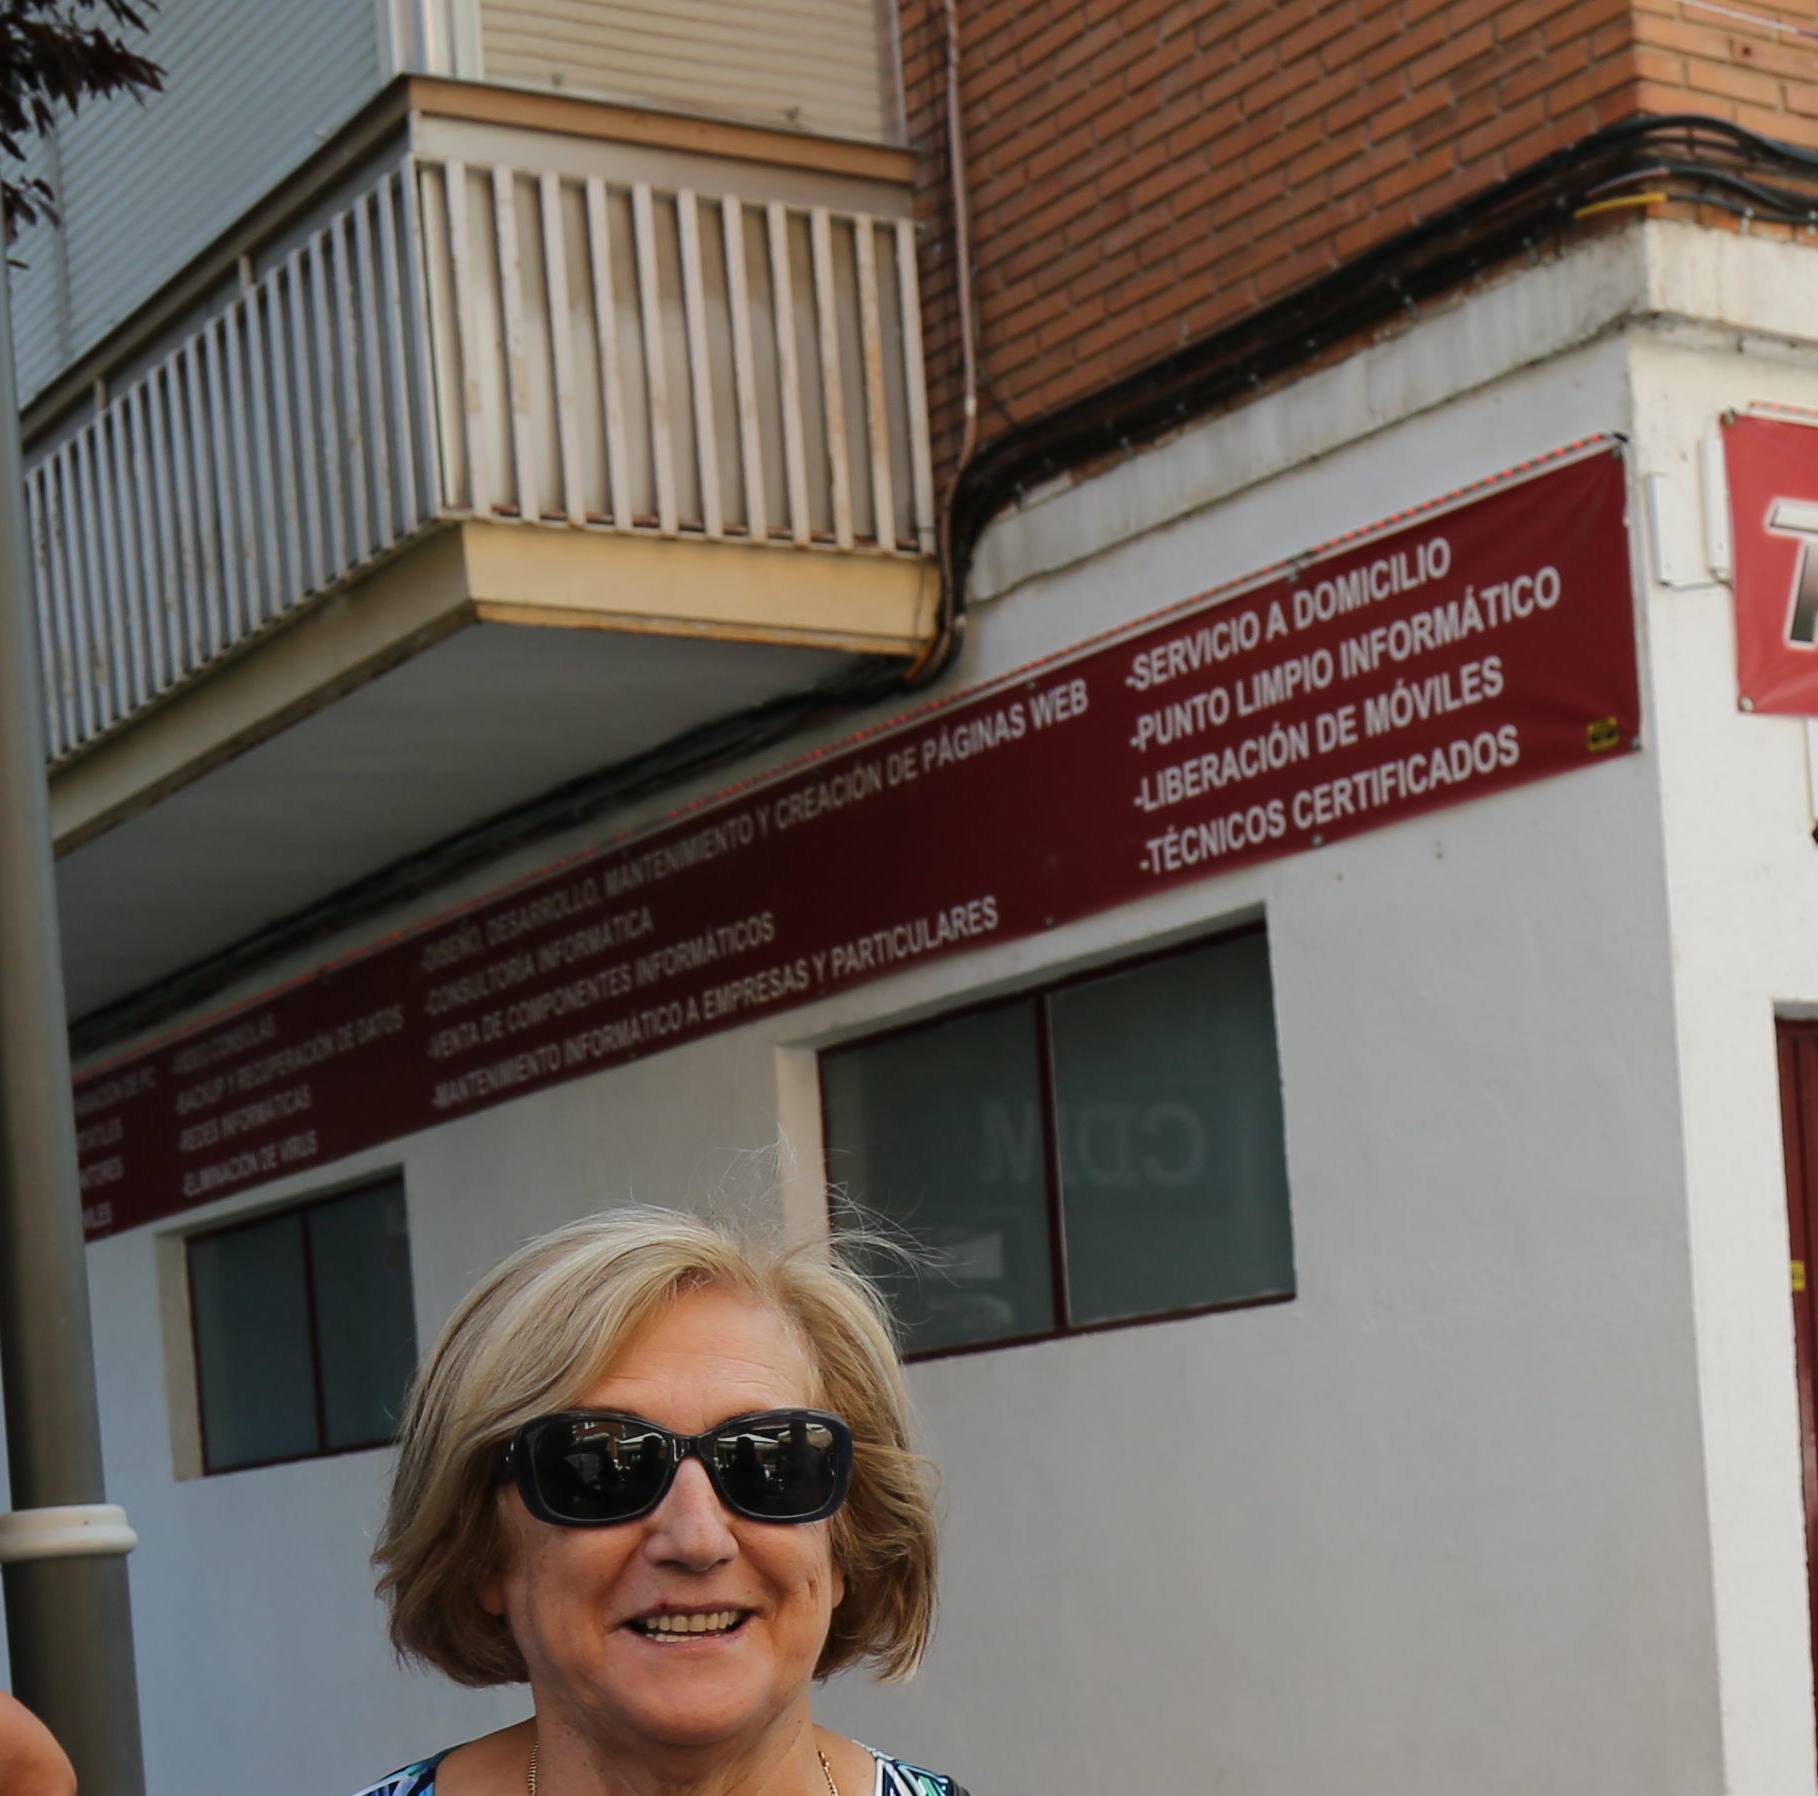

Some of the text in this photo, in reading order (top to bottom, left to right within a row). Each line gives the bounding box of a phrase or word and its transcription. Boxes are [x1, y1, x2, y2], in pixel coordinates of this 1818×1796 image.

[1237, 649, 1333, 717] LIMPIO
[1341, 566, 1561, 679] INFORMÁTICO
[1266, 606, 1288, 642] A
[1293, 537, 1451, 630] DOMICILIO
[1317, 706, 1358, 750] DE
[1365, 655, 1504, 737] MÓVILES
[604, 813, 754, 896] MANTENIMIENTO
[756, 806, 771, 836] Y
[775, 760, 882, 829] CREACIÓN
[887, 748, 918, 787] DE
[922, 704, 1026, 773] PÁGINAS
[1030, 679, 1088, 730] WEB
[1293, 724, 1520, 830] CERTIFICADOS
[483, 1013, 503, 1043] DE
[506, 963, 632, 1034] COMPONENTES
[634, 911, 775, 988] INFORMÁTICOS
[564, 1000, 680, 1066] INFORMÁTICO
[685, 997, 701, 1025] A
[703, 958, 809, 1020] EMPRESAS
[813, 951, 829, 983] Y
[832, 896, 999, 977] PARTICULARES
